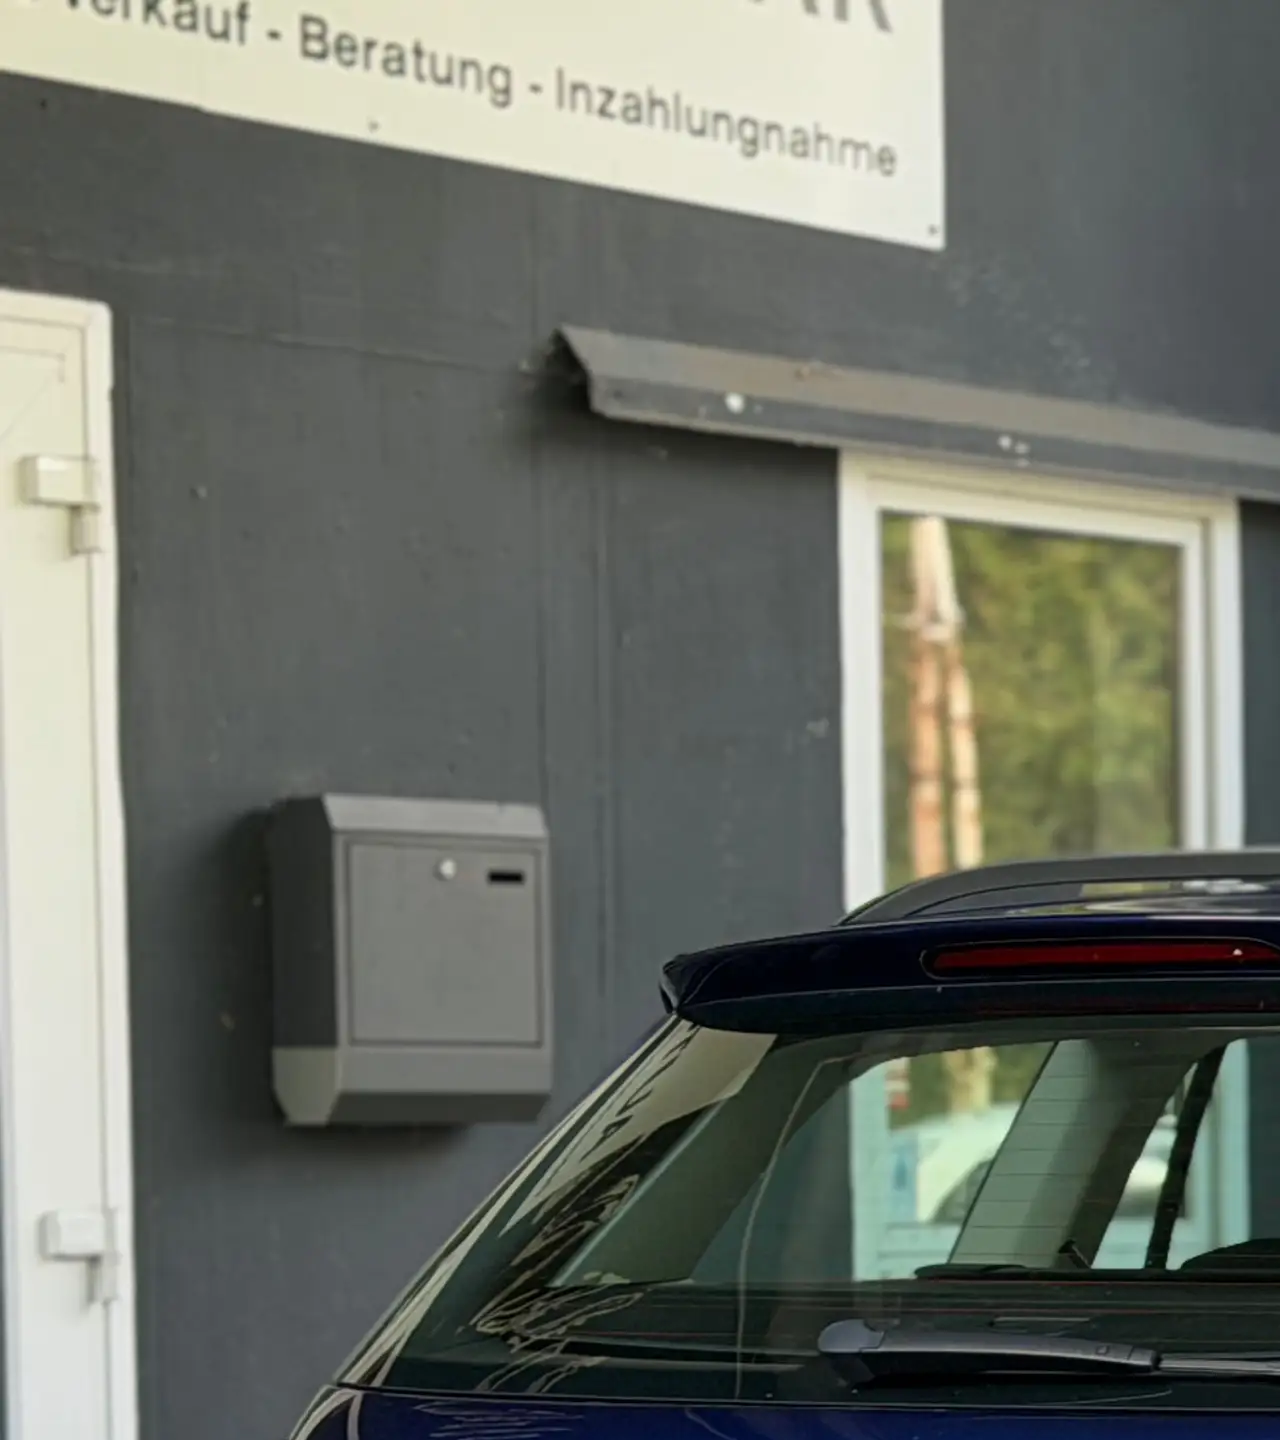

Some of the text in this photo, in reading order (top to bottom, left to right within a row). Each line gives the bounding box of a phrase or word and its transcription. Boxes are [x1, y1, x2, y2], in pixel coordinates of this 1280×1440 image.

[66, 0, 250, 46] erkauf
[299, 14, 512, 109] Beratung
[555, 66, 898, 177] Inzahlungnahme
